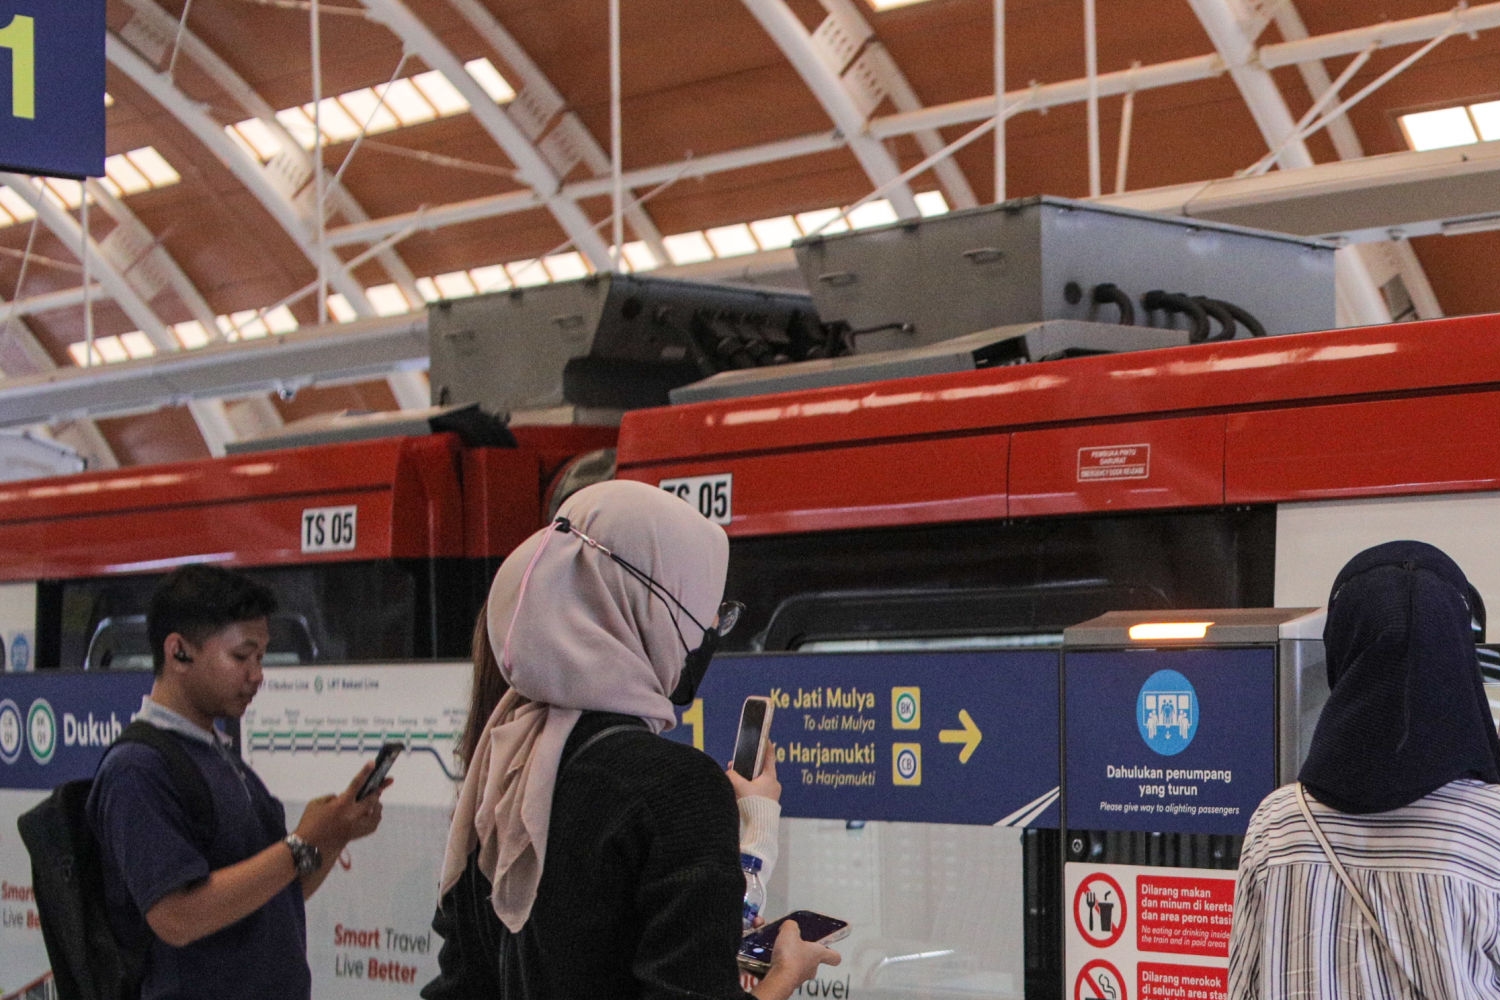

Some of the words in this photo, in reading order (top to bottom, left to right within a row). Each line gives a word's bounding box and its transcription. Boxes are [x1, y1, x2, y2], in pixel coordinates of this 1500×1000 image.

[0, 15, 34, 119] 1
[699, 481, 727, 519] 05
[305, 514, 325, 546] TS
[331, 512, 353, 544] 05
[770, 688, 789, 709] Ke
[793, 687, 822, 709] Jati
[826, 687, 875, 713] Mulya
[63, 711, 123, 746] Dukuh
[804, 714, 815, 730] To
[818, 715, 838, 730] Jati
[841, 715, 875, 733] Mulya
[789, 742, 875, 768] Harjamukti
[801, 769, 813, 784] To
[816, 770, 876, 790] Harjamukti
[1106, 765, 1163, 778] Dahulukan
[1166, 769, 1232, 783] penumpang
[1139, 784, 1165, 797] yang
[1167, 783, 1198, 795] turun
[1100, 801, 1123, 811] Please
[1124, 802, 1139, 813] give
[1140, 804, 1155, 813] way
[1156, 804, 1163, 812] to
[1165, 803, 1196, 815] alighting
[1198, 807, 1239, 816] passengers
[1141, 884, 1178, 898] Dilarang
[1181, 887, 1211, 897] makan
[1142, 897, 1158, 908] dan
[1160, 898, 1191, 909] minum
[1193, 900, 1201, 910] di
[1204, 900, 1233, 912] kereta
[1142, 910, 1158, 920] dan
[1161, 913, 1179, 922] area
[1182, 915, 1208, 924] peron
[1210, 914, 1233, 925] stasi
[335, 923, 380, 949] Smart
[386, 927, 431, 953] Travel
[1142, 925, 1151, 933] No
[1152, 927, 1172, 936] eating
[1182, 928, 1209, 937] drinking
[1142, 935, 1152, 943] the
[1191, 938, 1206, 947] paid
[335, 953, 364, 977] Live
[368, 957, 417, 984] Better
[798, 973, 850, 1000] ravel
[1142, 971, 1179, 986] Dilarang
[1182, 976, 1221, 987] merokok
[1142, 984, 1151, 994] di
[1153, 985, 1185, 997] seluruh
[1188, 990, 1207, 999] area
[1210, 991, 1227, 1000] stas
